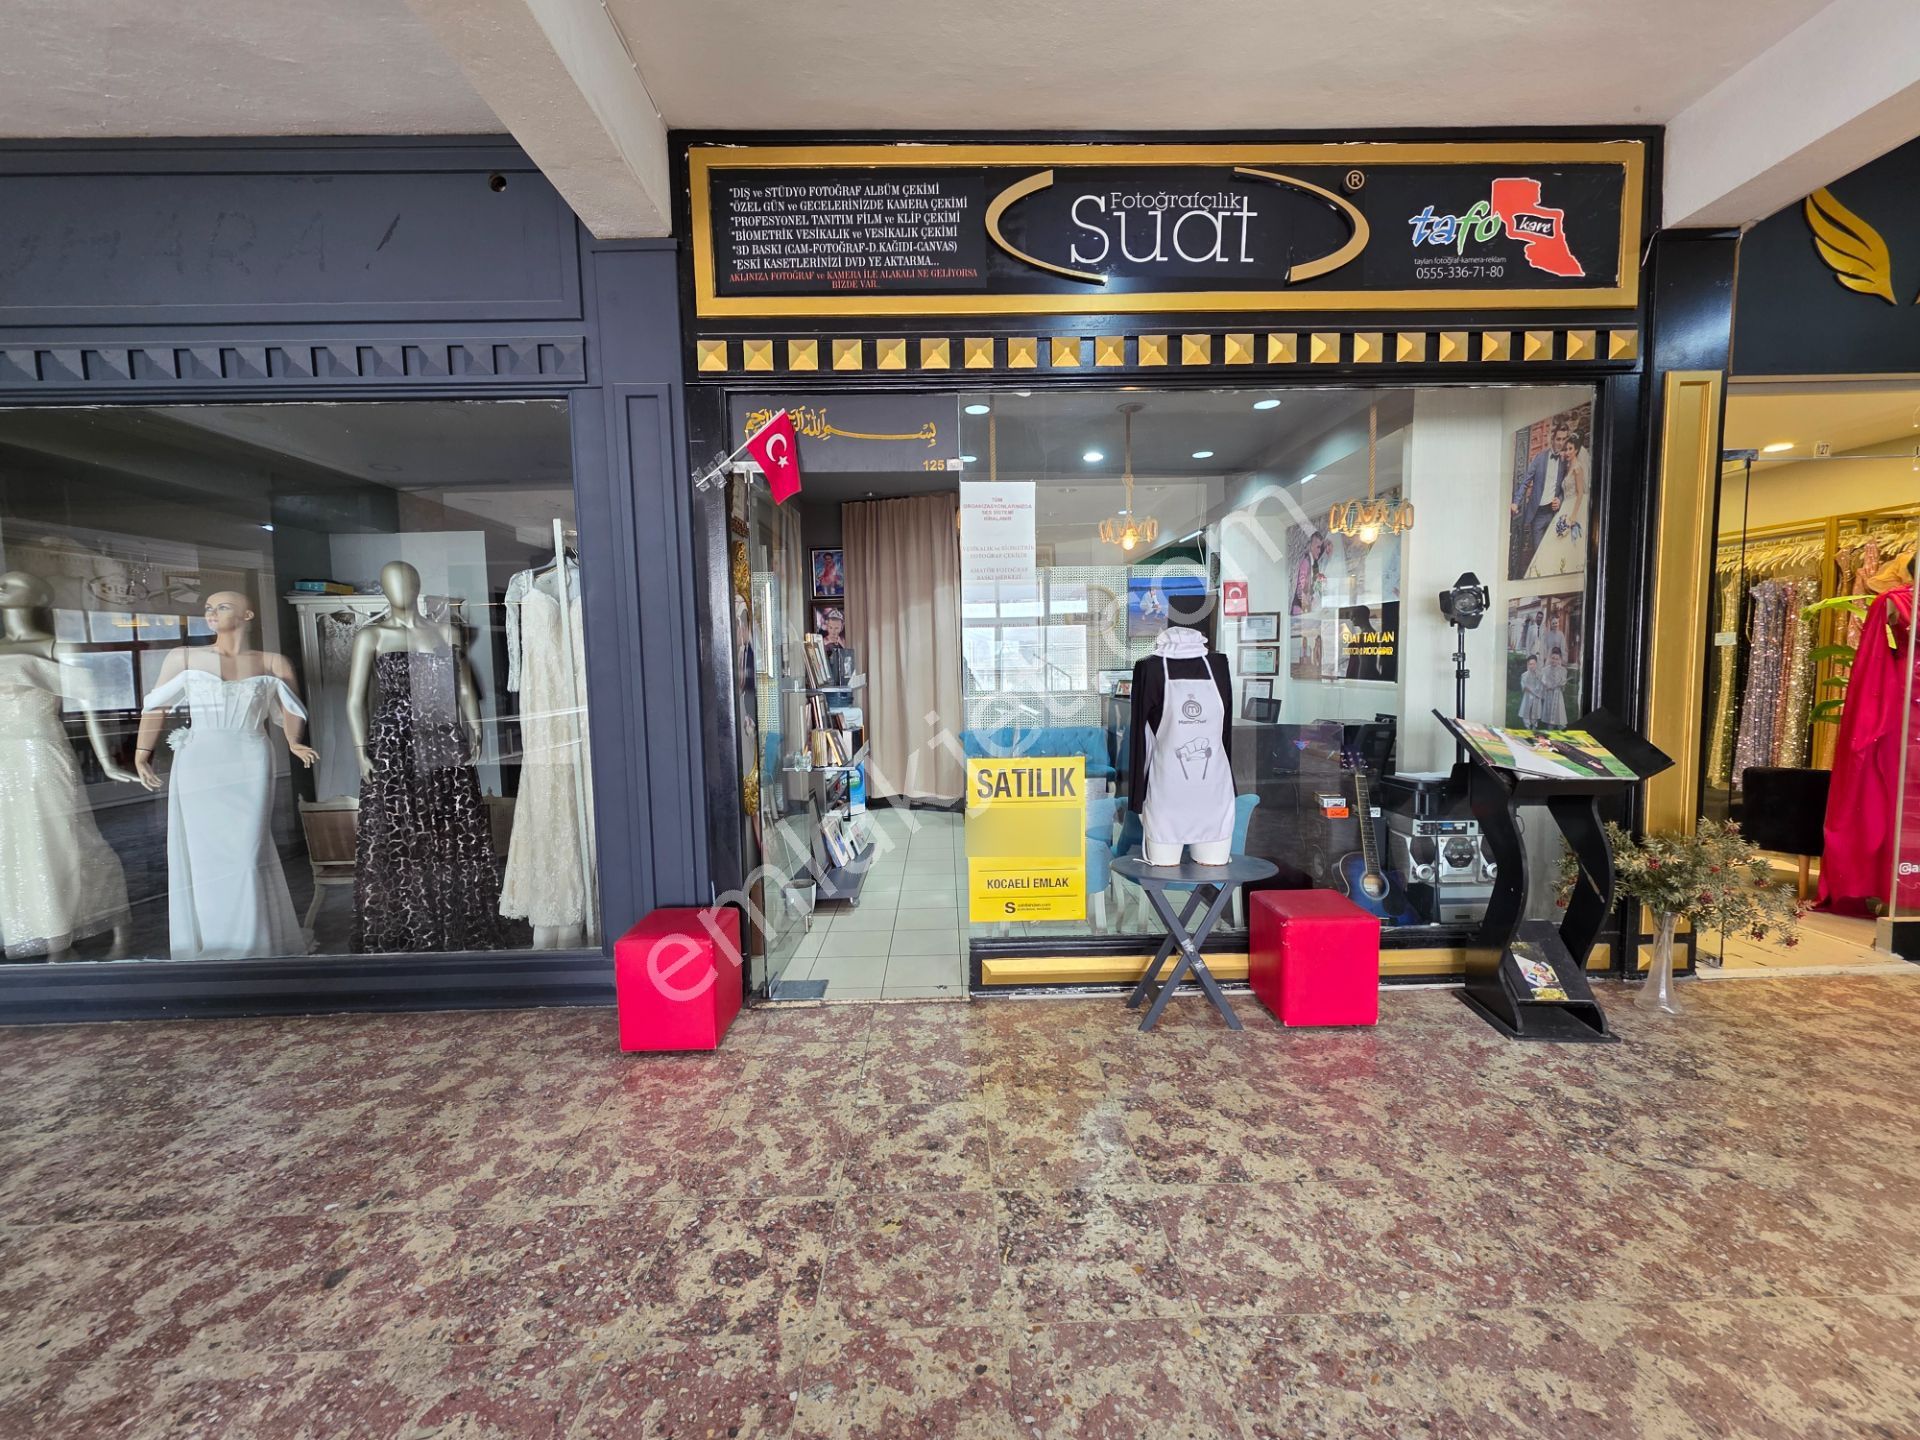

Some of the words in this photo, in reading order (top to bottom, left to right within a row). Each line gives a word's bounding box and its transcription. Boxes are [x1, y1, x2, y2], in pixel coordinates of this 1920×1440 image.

[765, 185, 806, 197] STÜDYO
[809, 184, 861, 196] FOTOĞRAF
[864, 183, 899, 196] ALBÜM
[902, 182, 939, 197] ÇEKİMİ
[763, 199, 784, 211] GÜN
[787, 203, 797, 211] ve
[800, 198, 883, 211] GECELERİNİZDE
[887, 198, 928, 210] KAMERA
[930, 195, 968, 211] ÇEKİMİ
[1110, 191, 1241, 212] Fotoğrafçılık
[811, 214, 853, 225] TANITIM
[857, 212, 882, 224] FİLM
[897, 211, 921, 224] KLİP
[924, 210, 960, 225] ÇEKİMİ
[796, 226, 850, 239] VESİKALIK
[865, 225, 918, 238] VESİKALIK
[921, 224, 957, 239] ÇEKİMİ
[1408, 200, 1502, 255] tafo
[752, 244, 781, 255] BASKI
[763, 255, 841, 269] KASETLERİNİZİ
[845, 256, 865, 267] DVD
[868, 256, 881, 267] YE
[1414, 257, 1433, 265] taylan
[771, 270, 814, 280] FOTOĞRAF
[827, 270, 861, 280] KAMERA
[880, 269, 914, 278] ALAKALI
[918, 269, 928, 277] NE
[1416, 266, 1504, 279] 0555-336-71-80
[923, 460, 944, 471] 125
[1363, 631, 1394, 643] TAYLAN
[977, 768, 1076, 798] SATILIK
[987, 877, 1030, 889] KOCAELİ
[1033, 877, 1069, 888] EMLAK
[1005, 902, 1016, 913] S
